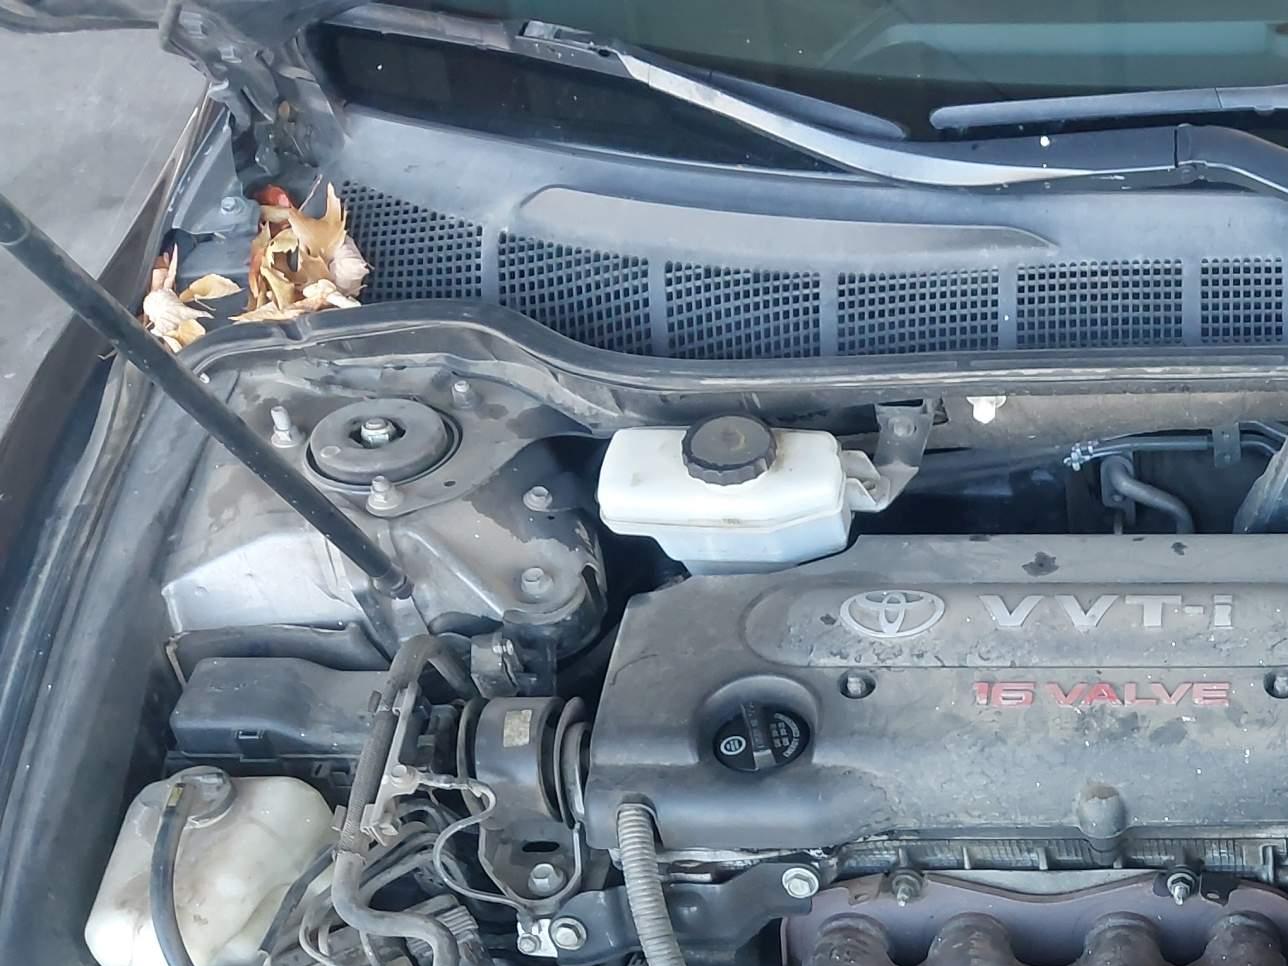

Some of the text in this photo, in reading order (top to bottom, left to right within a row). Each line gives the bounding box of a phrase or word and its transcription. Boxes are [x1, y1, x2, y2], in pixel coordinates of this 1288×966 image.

[979, 593, 1233, 630] VVT-i
[973, 681, 1231, 707] 16 VALVE
